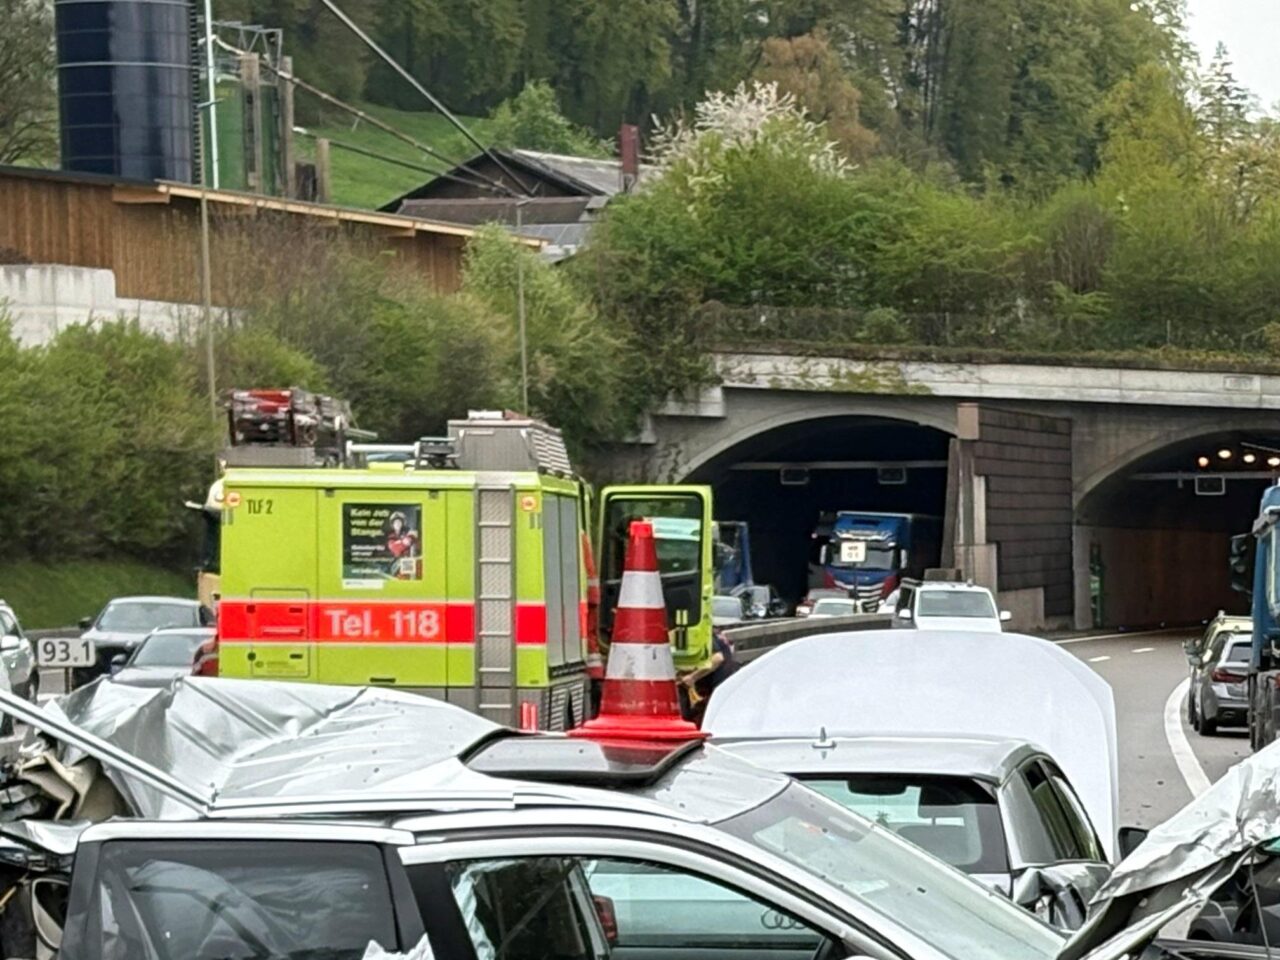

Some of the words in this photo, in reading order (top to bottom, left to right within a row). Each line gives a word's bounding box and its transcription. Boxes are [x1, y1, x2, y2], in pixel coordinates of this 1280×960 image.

[246, 499, 264, 515] TLF
[265, 499, 273, 515] 2
[324, 609, 380, 637] Tel.
[389, 608, 440, 638] 118
[43, 641, 90, 662] 93.1
